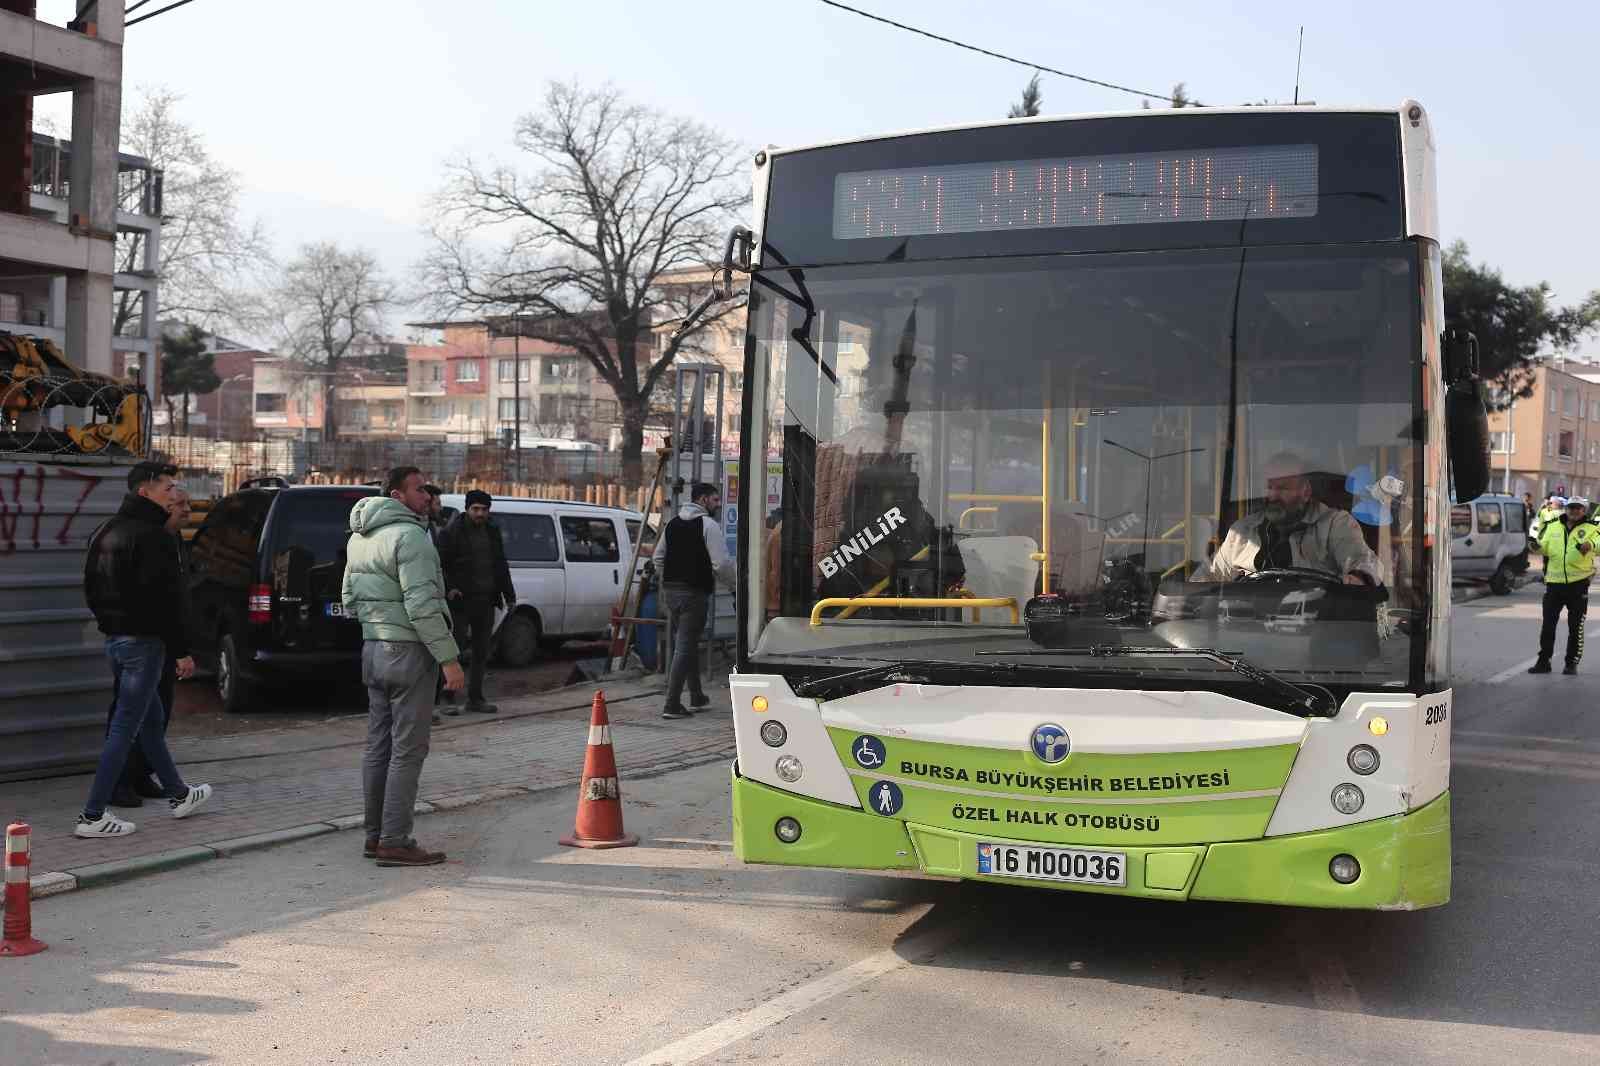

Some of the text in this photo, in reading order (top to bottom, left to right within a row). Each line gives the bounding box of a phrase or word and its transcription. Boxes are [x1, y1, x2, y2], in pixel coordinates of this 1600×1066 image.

[900, 761, 1230, 794] BURSA BÜYÜKŞEHİR BELEDİYESİ
[952, 803, 1160, 832] ÖZEL HALK OTOBÜSÜ
[993, 847, 1019, 872] 16
